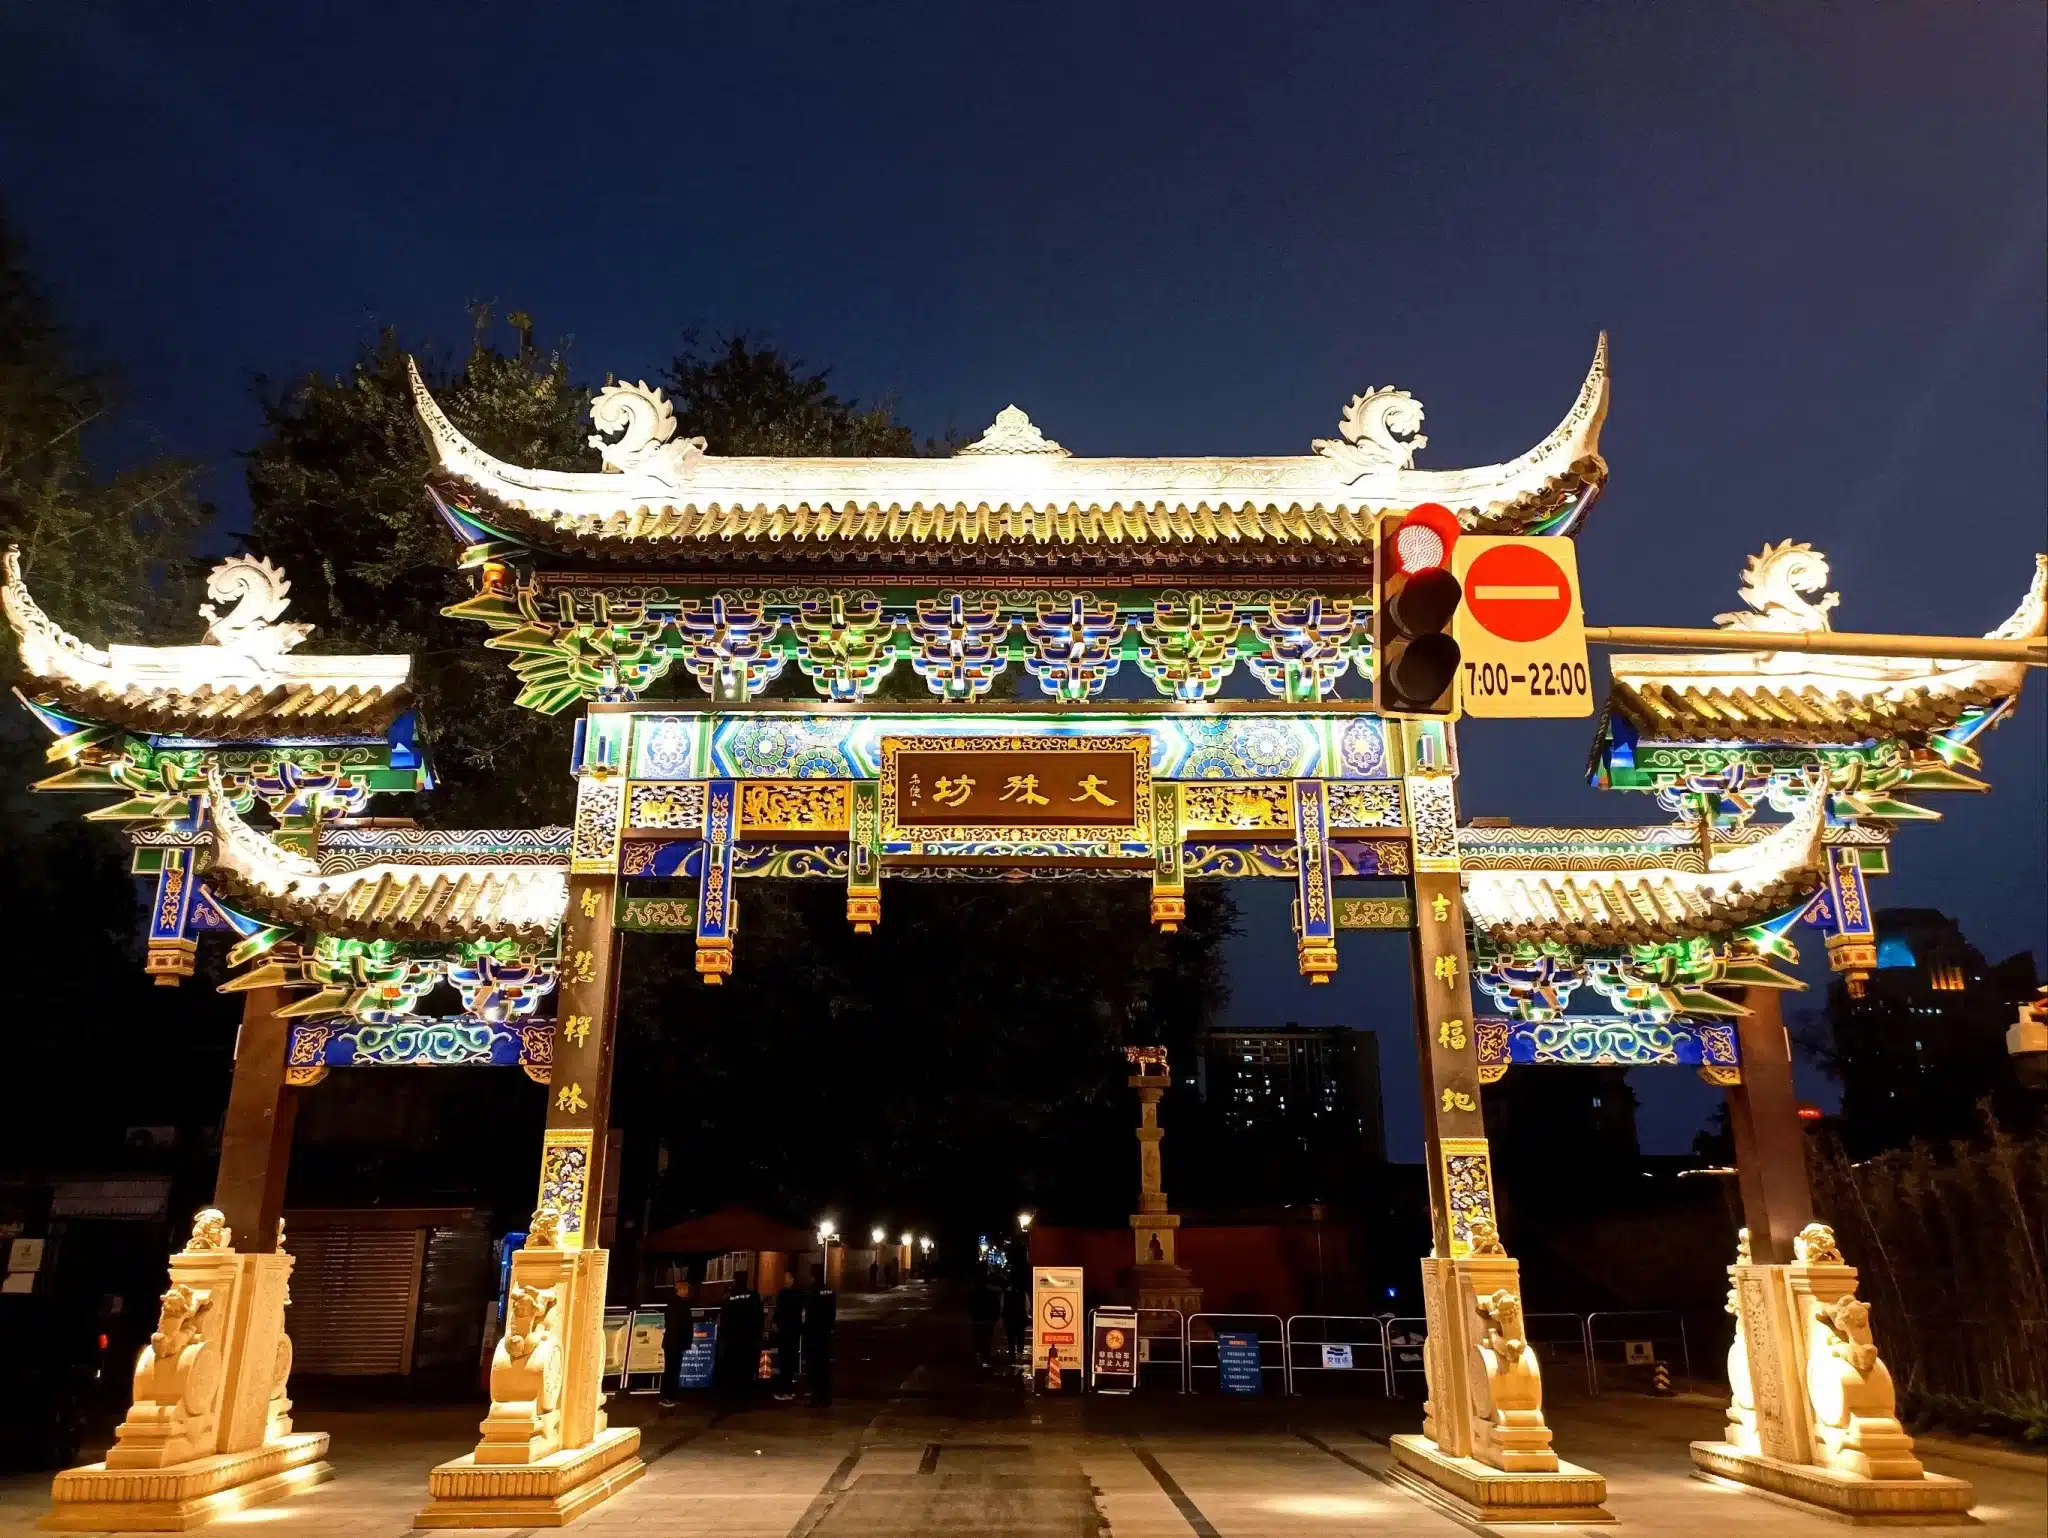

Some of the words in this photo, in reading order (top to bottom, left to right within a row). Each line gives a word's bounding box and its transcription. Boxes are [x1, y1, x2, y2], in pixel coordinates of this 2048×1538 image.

[1465, 662, 1586, 696] 7:00-22:00
[933, 773, 1119, 807] 文殊坊
[1431, 893, 1477, 1113] 吉祥福地
